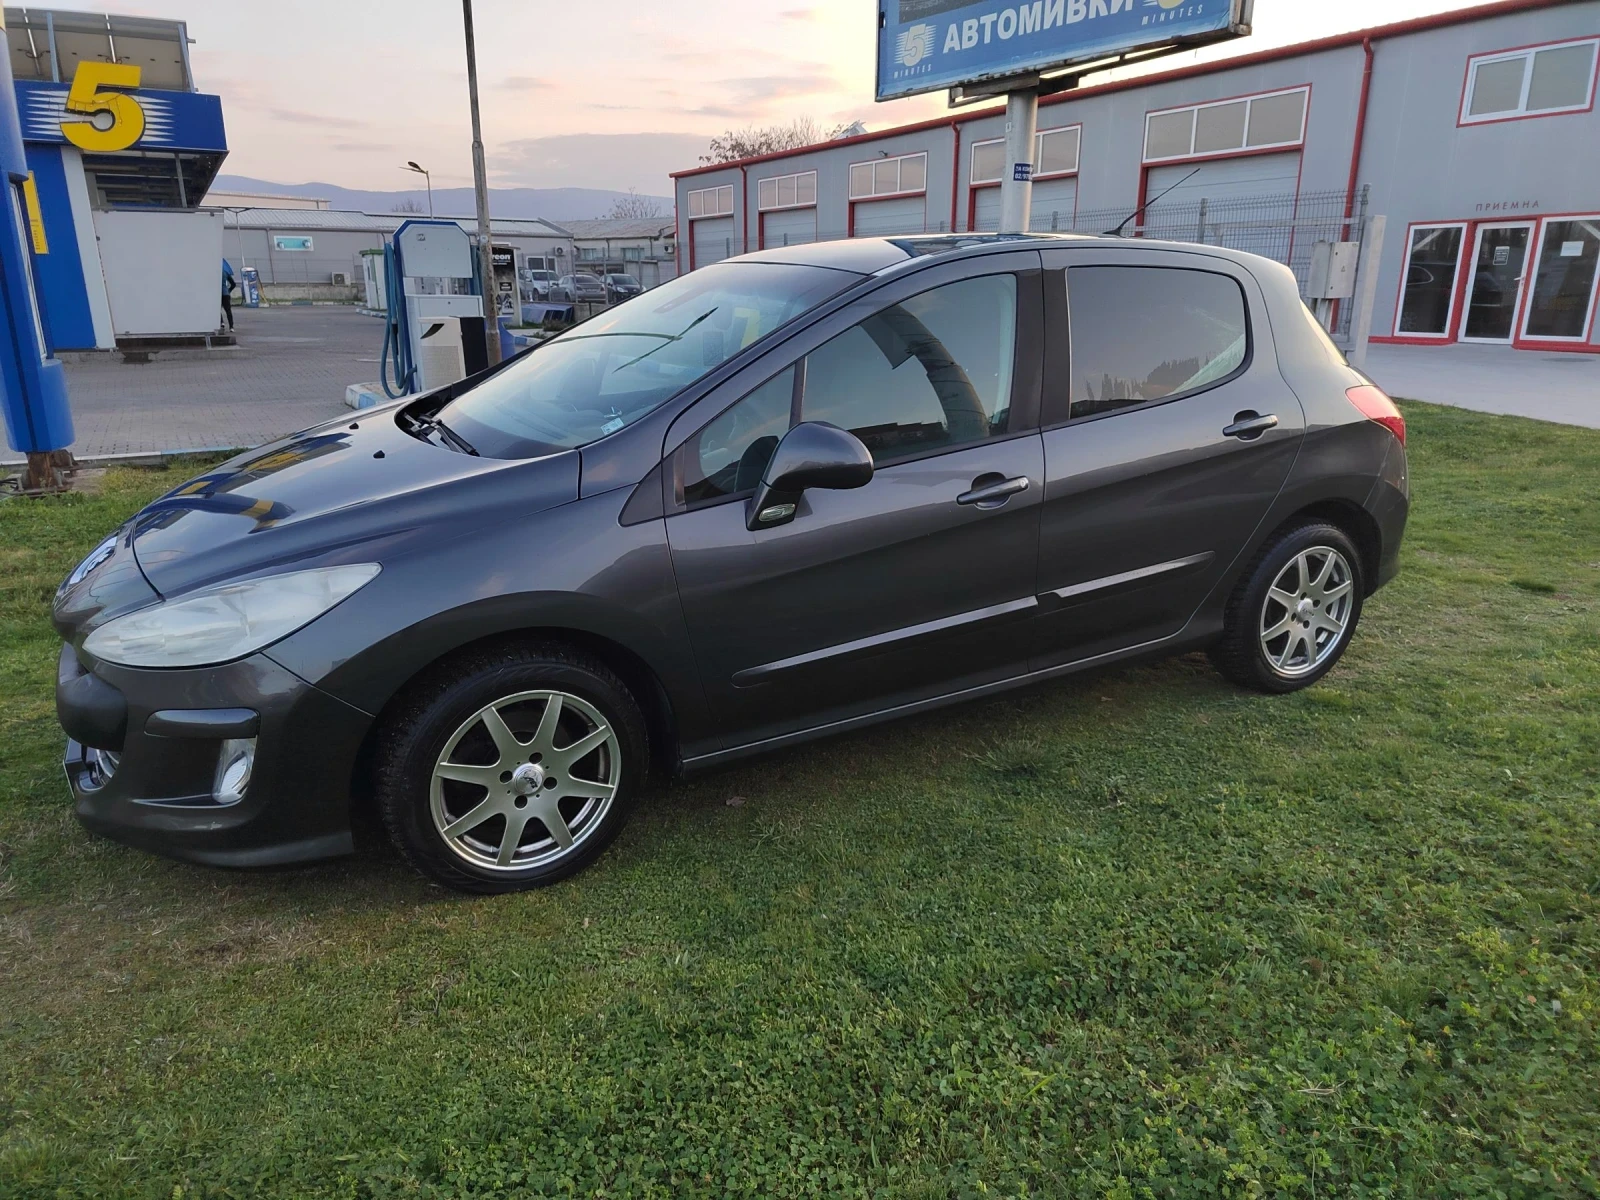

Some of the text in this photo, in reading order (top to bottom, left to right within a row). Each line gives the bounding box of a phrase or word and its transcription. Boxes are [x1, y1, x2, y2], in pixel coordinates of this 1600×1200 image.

[1141, 4, 1204, 26] MINUTES
[902, 23, 926, 67] 5
[893, 63, 932, 79] MINUTES
[60, 60, 146, 152] 5
[1475, 200, 1539, 212] ПРИЕМНА
